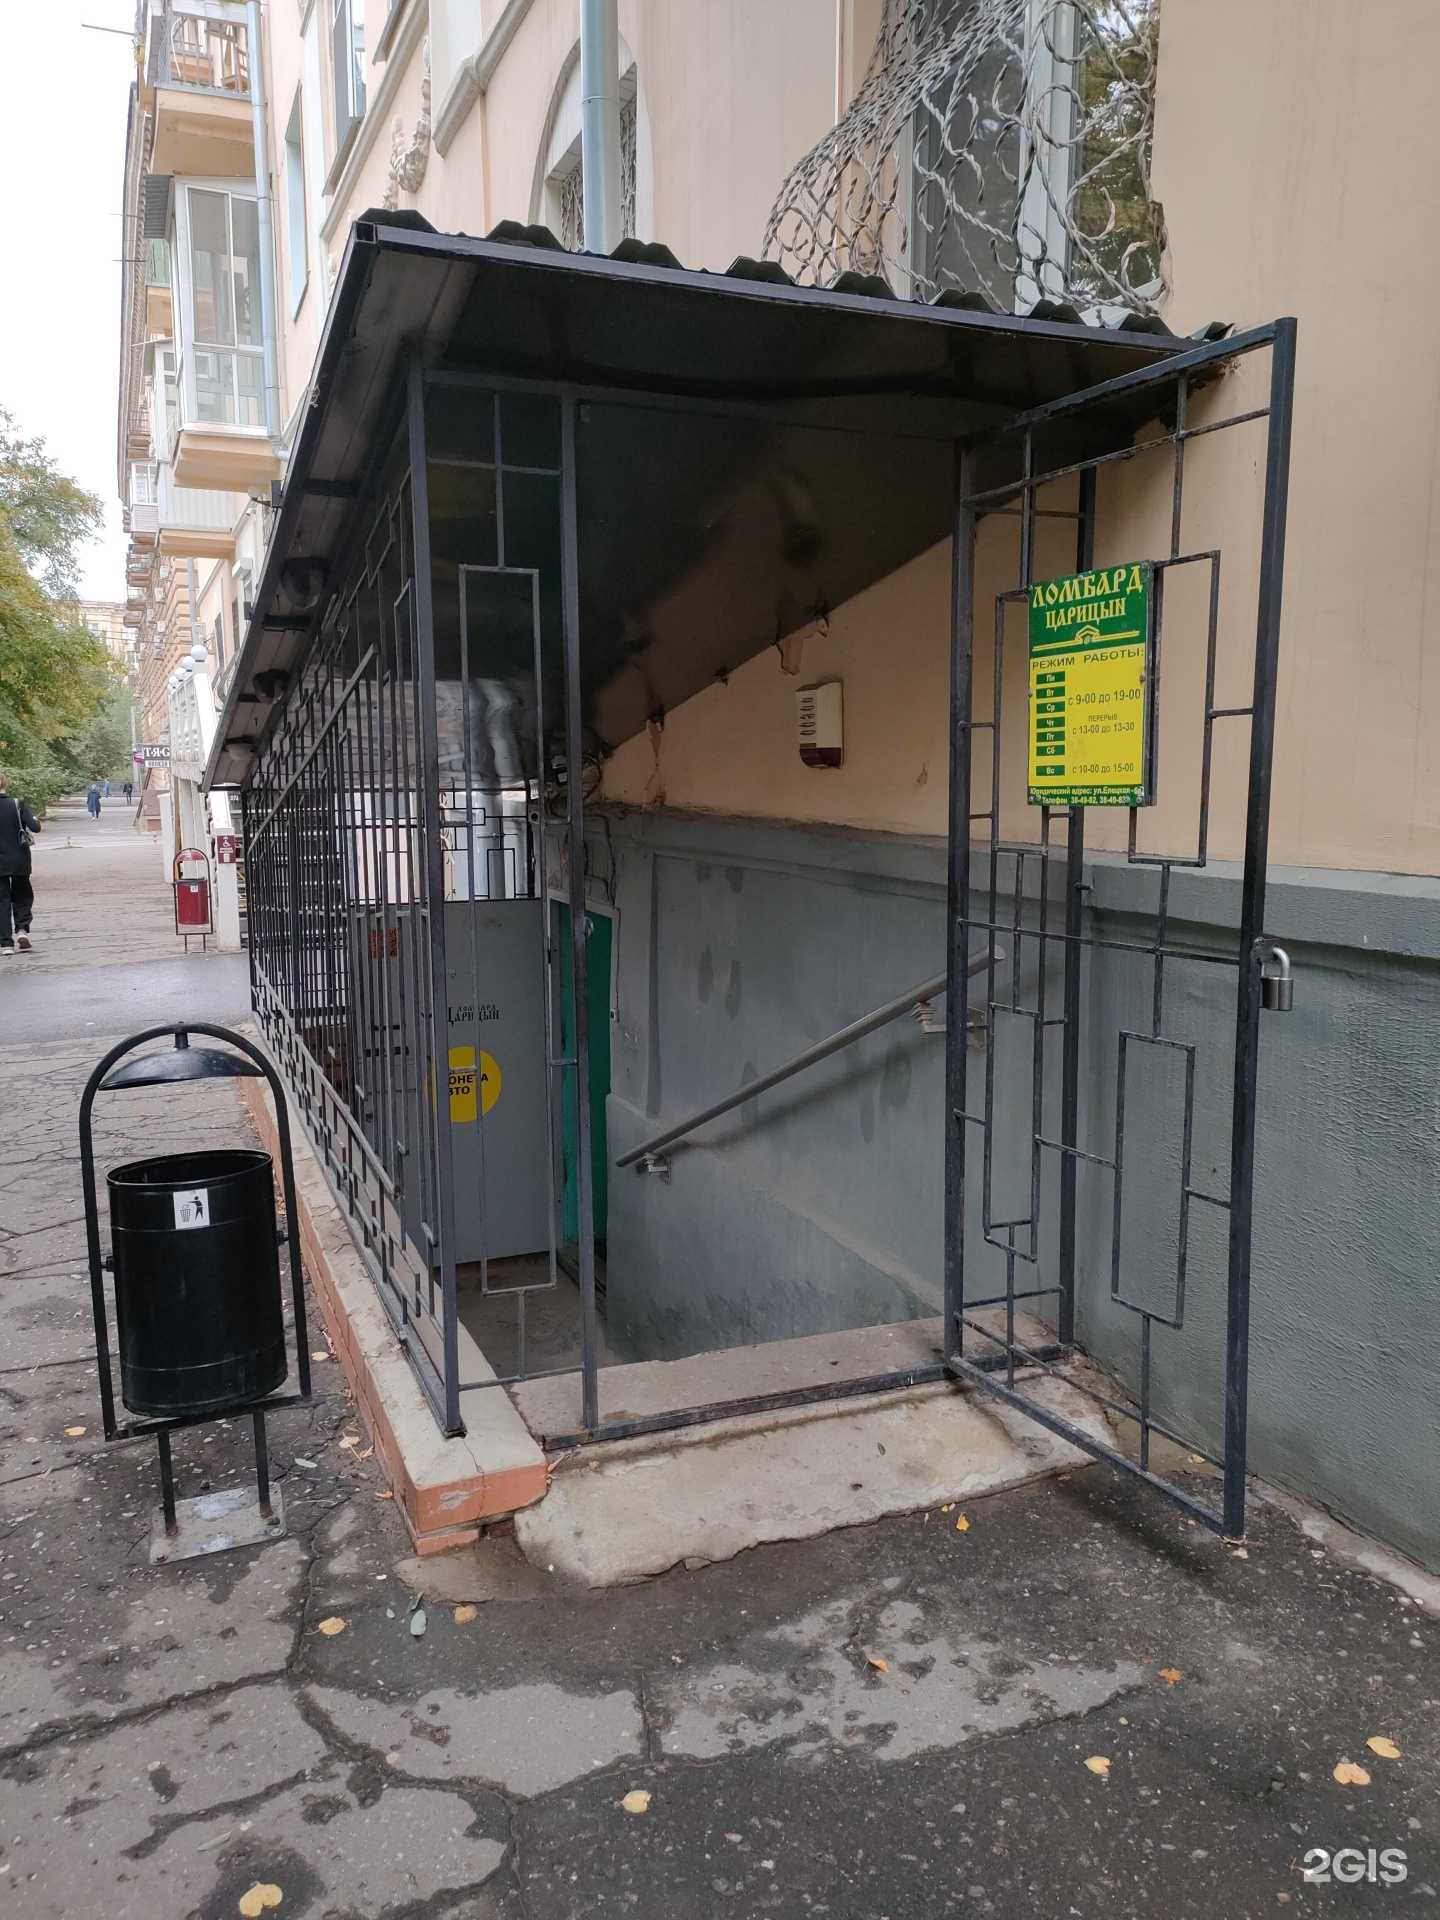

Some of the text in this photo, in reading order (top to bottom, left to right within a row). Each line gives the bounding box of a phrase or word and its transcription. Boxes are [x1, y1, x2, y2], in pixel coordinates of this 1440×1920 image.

[1033, 565, 1143, 608] ЛОМБАРД
[1045, 597, 1126, 632] ЦАРИЦЫН
[1032, 648, 1144, 669] РЕЖИМ РАБОТЫ:
[1046, 673, 1055, 682] Пн
[1046, 688, 1054, 697] Вт
[1076, 693, 1096, 705] 9-00
[1099, 695, 1111, 704] до
[1114, 688, 1141, 701] 19-00
[1046, 704, 1055, 712] Ср
[1046, 719, 1054, 727] Чт
[1080, 725, 1100, 735] 13-00
[1101, 726, 1111, 734] до
[1114, 722, 1135, 732] 13-30
[1046, 733, 1054, 741] Пт
[1046, 746, 1055, 755] Сб
[1101, 765, 1111, 773] до
[1114, 763, 1134, 772] 15-00
